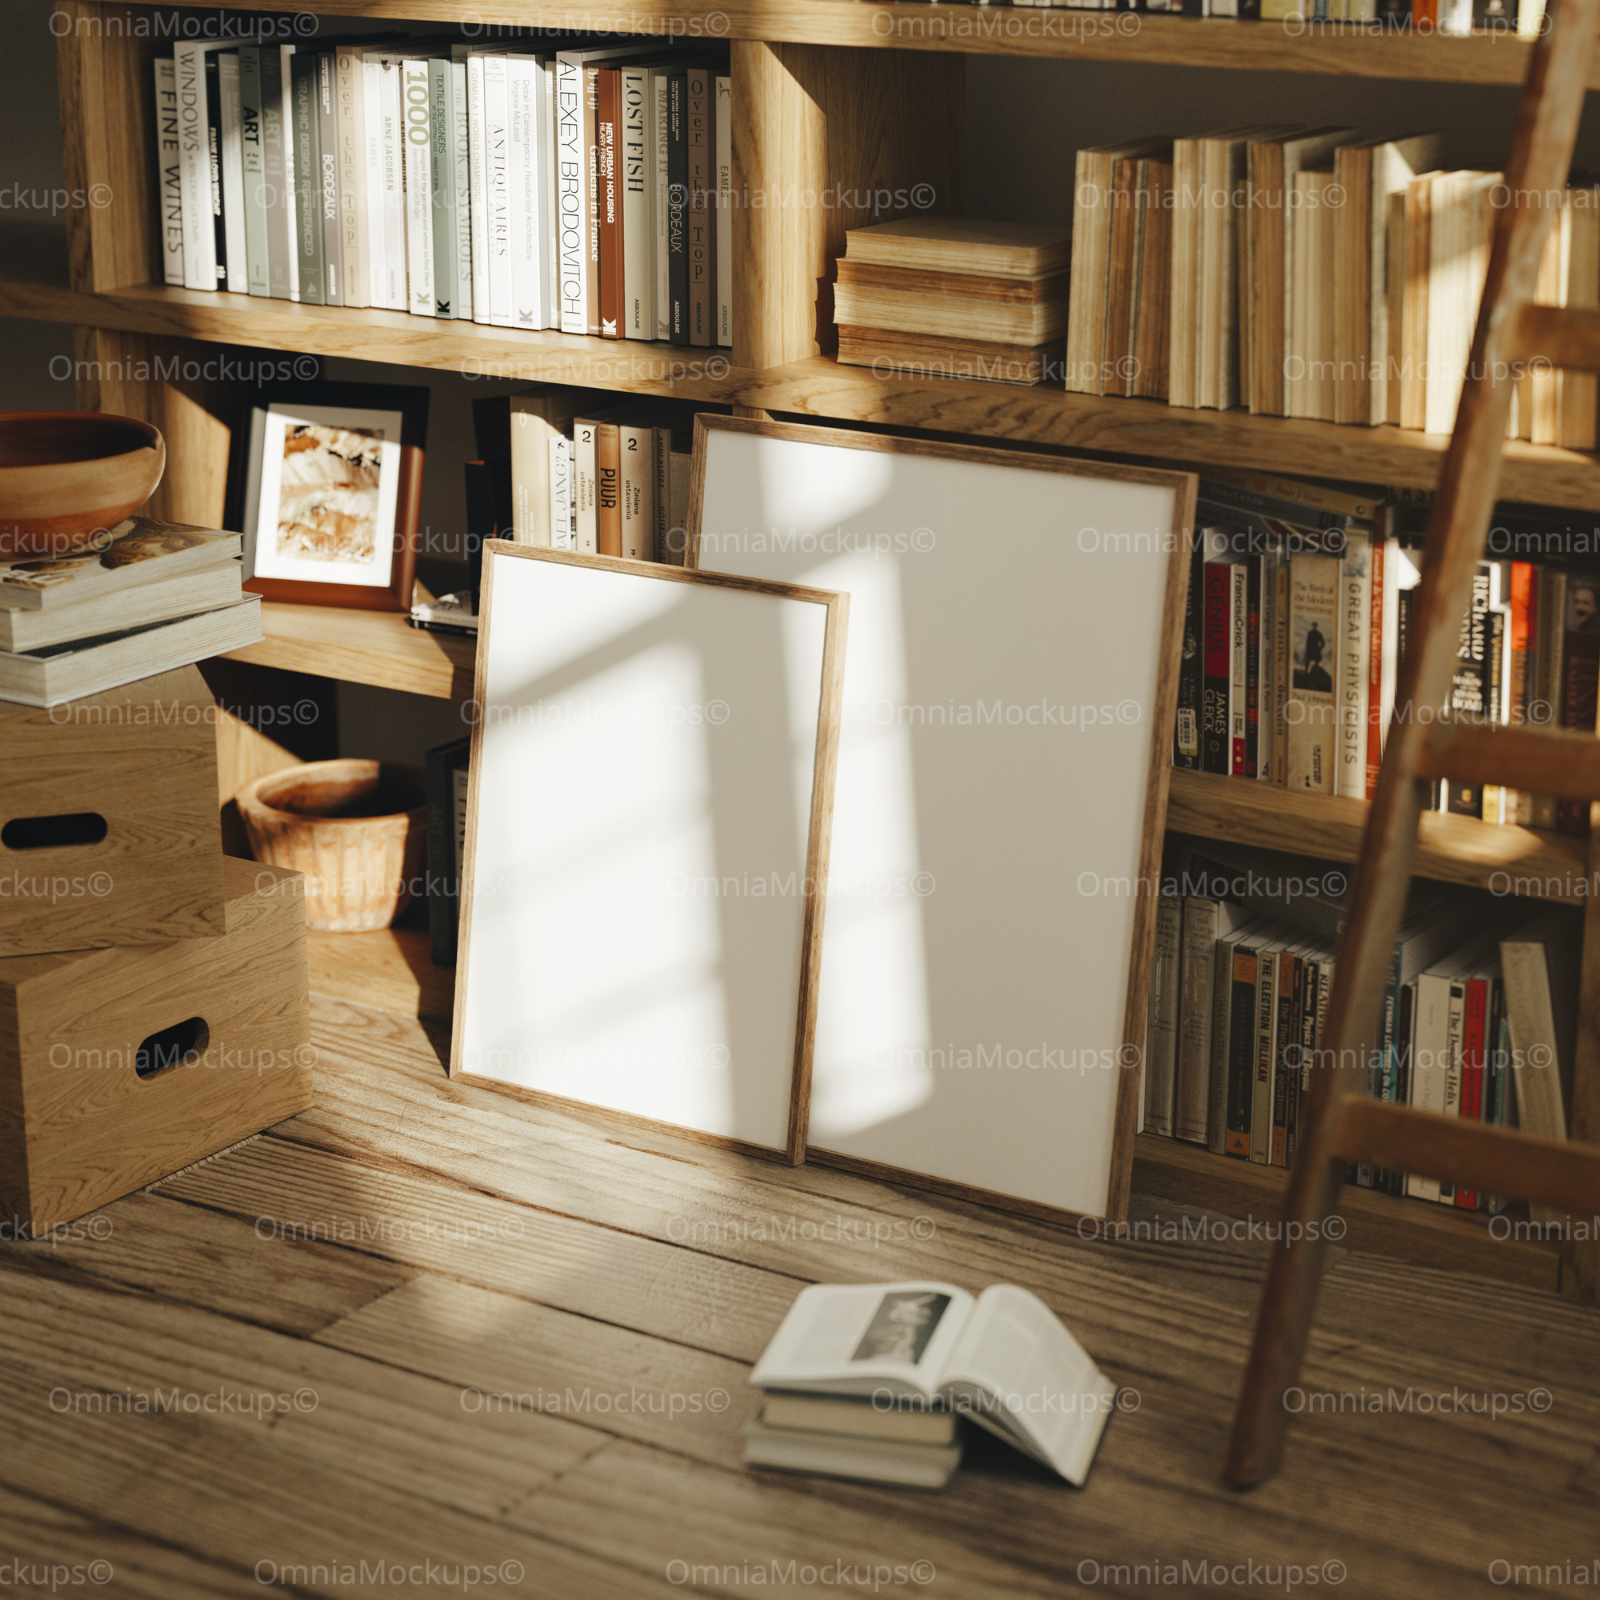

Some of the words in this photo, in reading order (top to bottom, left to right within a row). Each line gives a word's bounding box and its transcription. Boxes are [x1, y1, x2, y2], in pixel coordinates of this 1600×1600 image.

[180, 51, 200, 151] WINDOWS
[298, 77, 309, 130] GRAPHIC
[339, 55, 350, 116] Over
[406, 71, 430, 146] 1000
[436, 73, 445, 106] TEXTILE
[471, 67, 479, 109] FORMULA
[511, 80, 520, 108] Virginia
[522, 79, 530, 102] Detail
[559, 59, 578, 154] ALEXEY
[626, 76, 643, 136] LOST
[161, 90, 179, 151] FINE
[243, 106, 259, 146] ART
[265, 107, 280, 148] ART
[384, 116, 392, 140] ARNE
[437, 108, 447, 154] DESIGNERS
[472, 118, 480, 150] WORLD
[658, 88, 668, 155] MAKING
[691, 79, 703, 143] Over
[300, 133, 311, 176] DESIGN
[368, 136, 377, 168] EAMES
[456, 111, 470, 165] BOOK
[523, 113, 531, 168] Contemporary
[211, 154, 219, 181] LLOYD
[385, 143, 394, 190] JACOBSEN
[458, 170, 464, 181] OF
[473, 152, 481, 203] CHAMPIONS
[589, 144, 600, 198] Gardens
[606, 146, 614, 179] URBAN
[627, 143, 644, 193] FISH
[721, 165, 729, 198] EAMES
[165, 163, 183, 253] WINES
[322, 154, 336, 220] BORDEAUX
[493, 124, 507, 256] ANTIQUAIRES
[590, 200, 600, 214] in
[694, 163, 703, 210] the
[302, 179, 314, 256] REFERENCED
[458, 187, 472, 281] SYMBOLS
[561, 161, 581, 315] BRODOVITCH
[591, 217, 601, 262] France
[670, 184, 683, 253] BORDEAUX
[582, 430, 591, 443] 2
[628, 437, 638, 451] 2
[555, 456, 567, 511] JANG?
[600, 468, 616, 509] PUUR
[1208, 577, 1225, 654] GENIUS
[1234, 618, 1244, 648] Crick
[1347, 582, 1361, 644] GREAT
[1472, 575, 1489, 661] RICHARD
[1204, 688, 1216, 732] GLEICK
[1215, 690, 1227, 735] JAMES
[1344, 652, 1360, 765] PHYSICISTS
[1262, 959, 1273, 977] THE
[1260, 980, 1272, 1030] ELECTRON
[1279, 1002, 1290, 1020] the
[1385, 995, 1395, 1033] FEYNMAN
[1450, 1010, 1461, 1030] The
[1216, 995, 1227, 1062] CALCULATING
[1277, 1023, 1289, 1056] theory
[1302, 1015, 1314, 1045] Physics
[1257, 1035, 1270, 1083] MILLIKAN
[1278, 1060, 1288, 1070] of
[1382, 1075, 1391, 1086] ON
[1214, 1066, 1223, 1109] ENGINES
[1275, 1073, 1287, 1121] electrons
[1446, 1075, 1458, 1106] Helix
